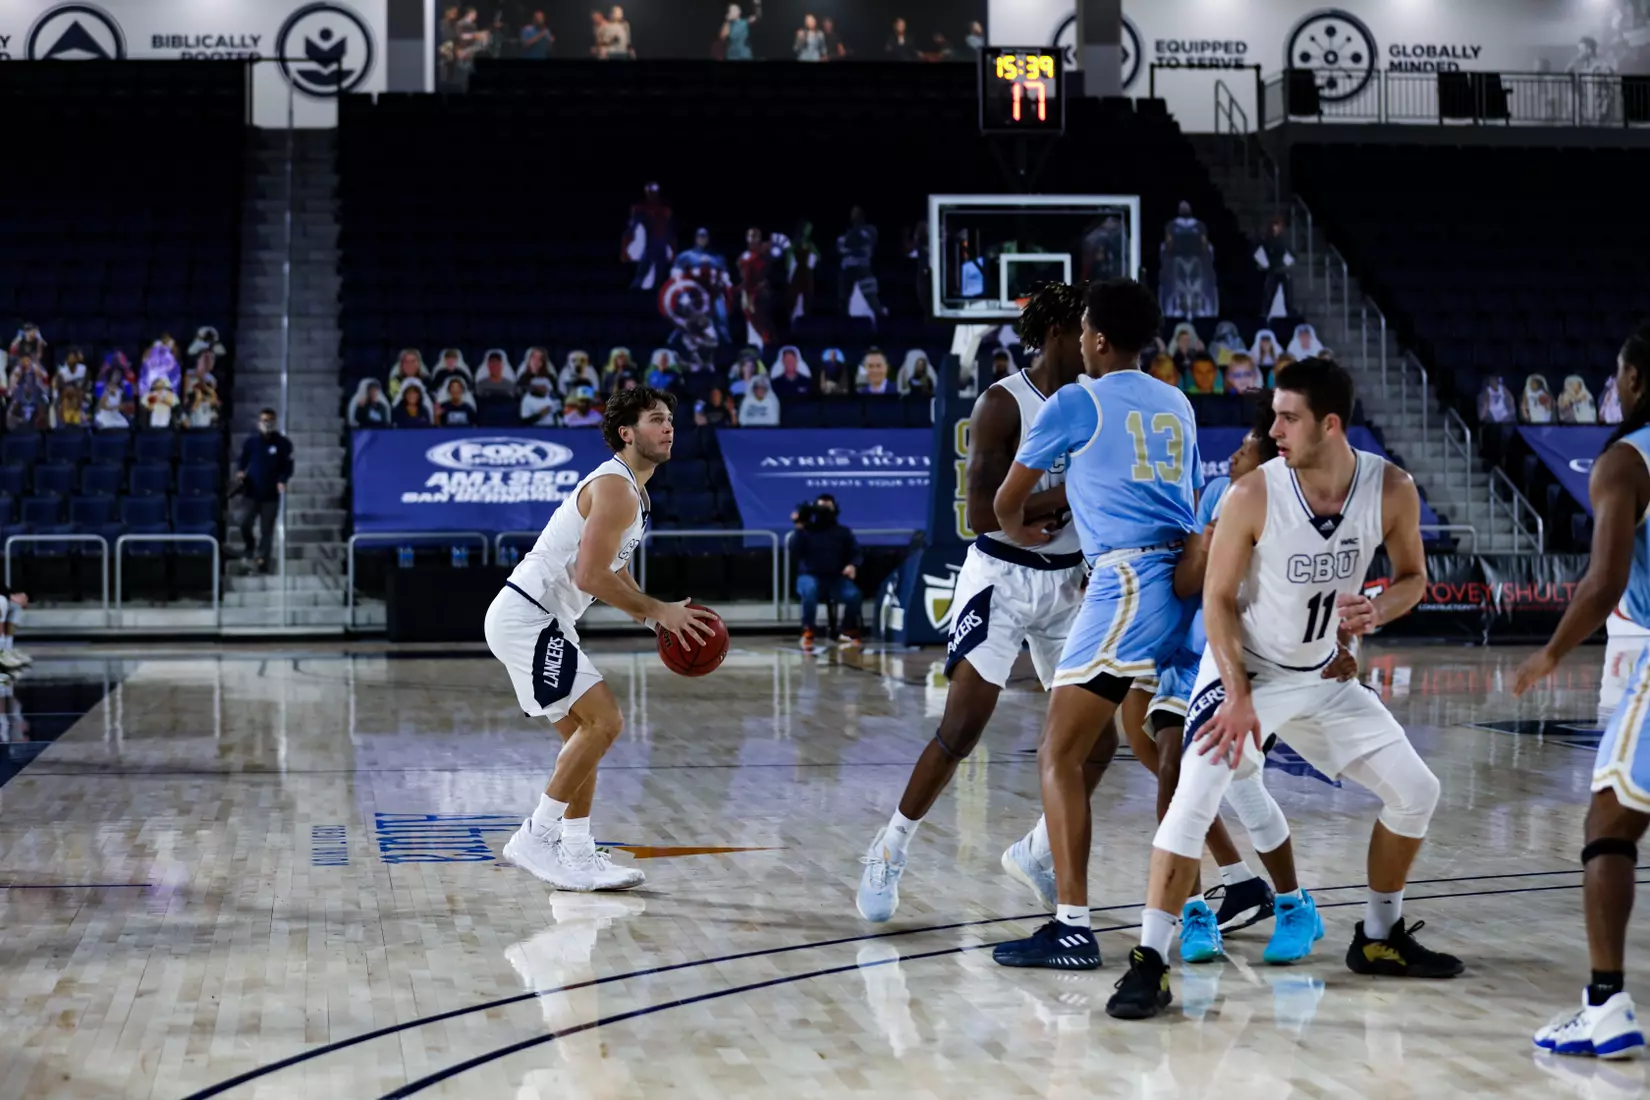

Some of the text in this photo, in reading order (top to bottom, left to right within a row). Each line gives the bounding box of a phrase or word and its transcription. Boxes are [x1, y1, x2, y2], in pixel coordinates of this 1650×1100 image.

[152, 35, 261, 48] BIBLICALLY
[1155, 41, 1247, 54] EQUIPPED
[1388, 45, 1481, 59] GLOBALLY
[996, 55, 1054, 80] 15:39
[1389, 61, 1460, 73] MINDED
[1012, 82, 1046, 121] 17
[459, 443, 543, 465] FOX
[1125, 410, 1183, 483] 13
[1287, 549, 1360, 584] CBU
[1302, 589, 1337, 643] 11
[947, 609, 983, 655] ANCERS
[543, 636, 565, 689] LANCERS
